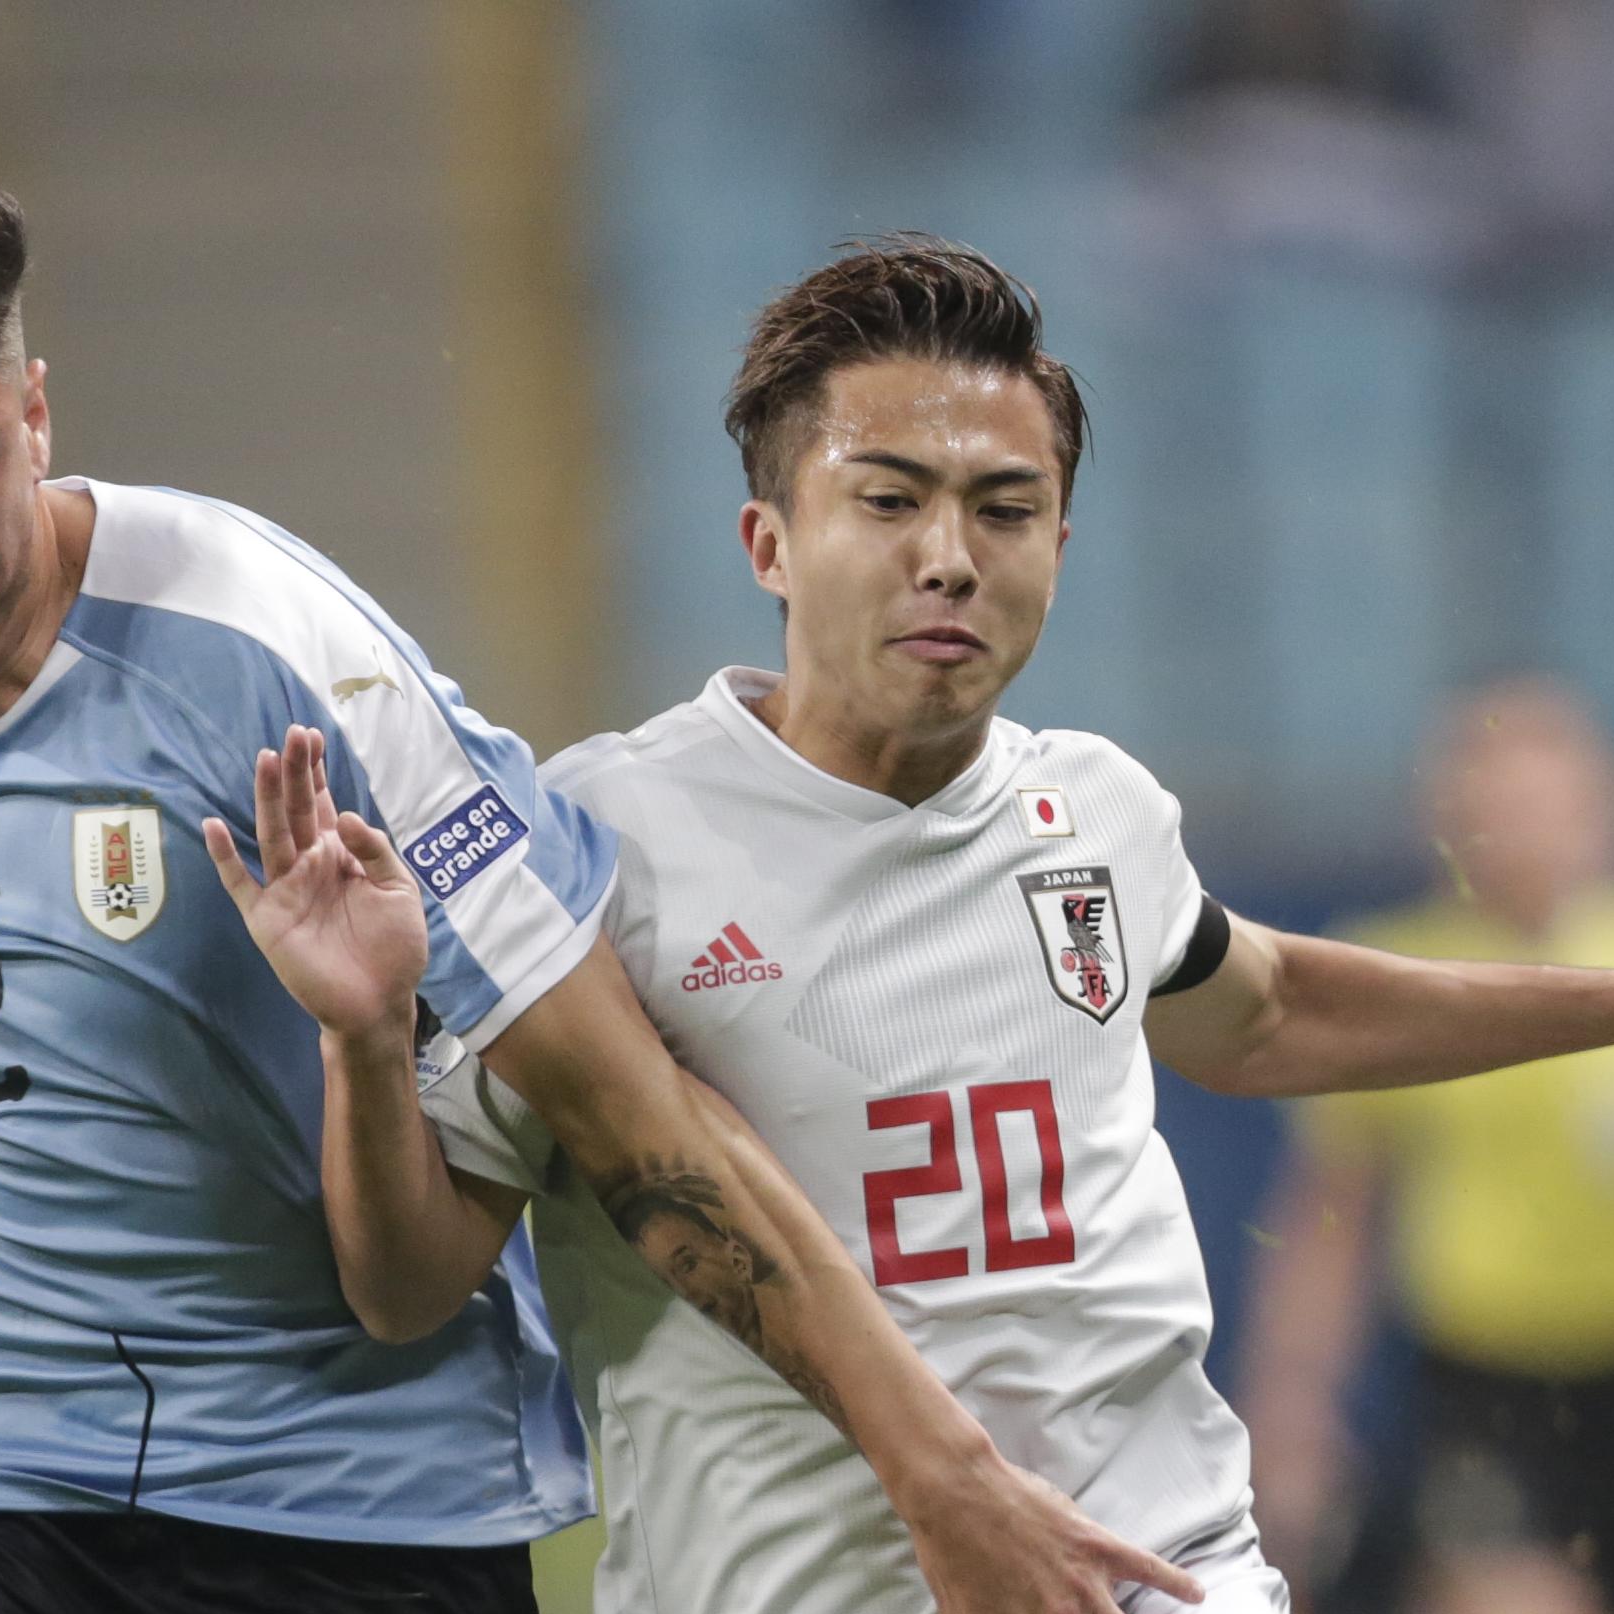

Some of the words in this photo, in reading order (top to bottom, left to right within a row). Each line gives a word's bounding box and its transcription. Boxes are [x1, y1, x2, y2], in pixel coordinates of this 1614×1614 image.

[108, 833, 127, 878] AUF
[413, 822, 469, 867] Cree
[468, 798, 500, 827] en
[431, 820, 511, 893] grande
[1043, 871, 1093, 886] JAPAN
[681, 961, 783, 992] adidas
[863, 1079, 1075, 1287] 20
